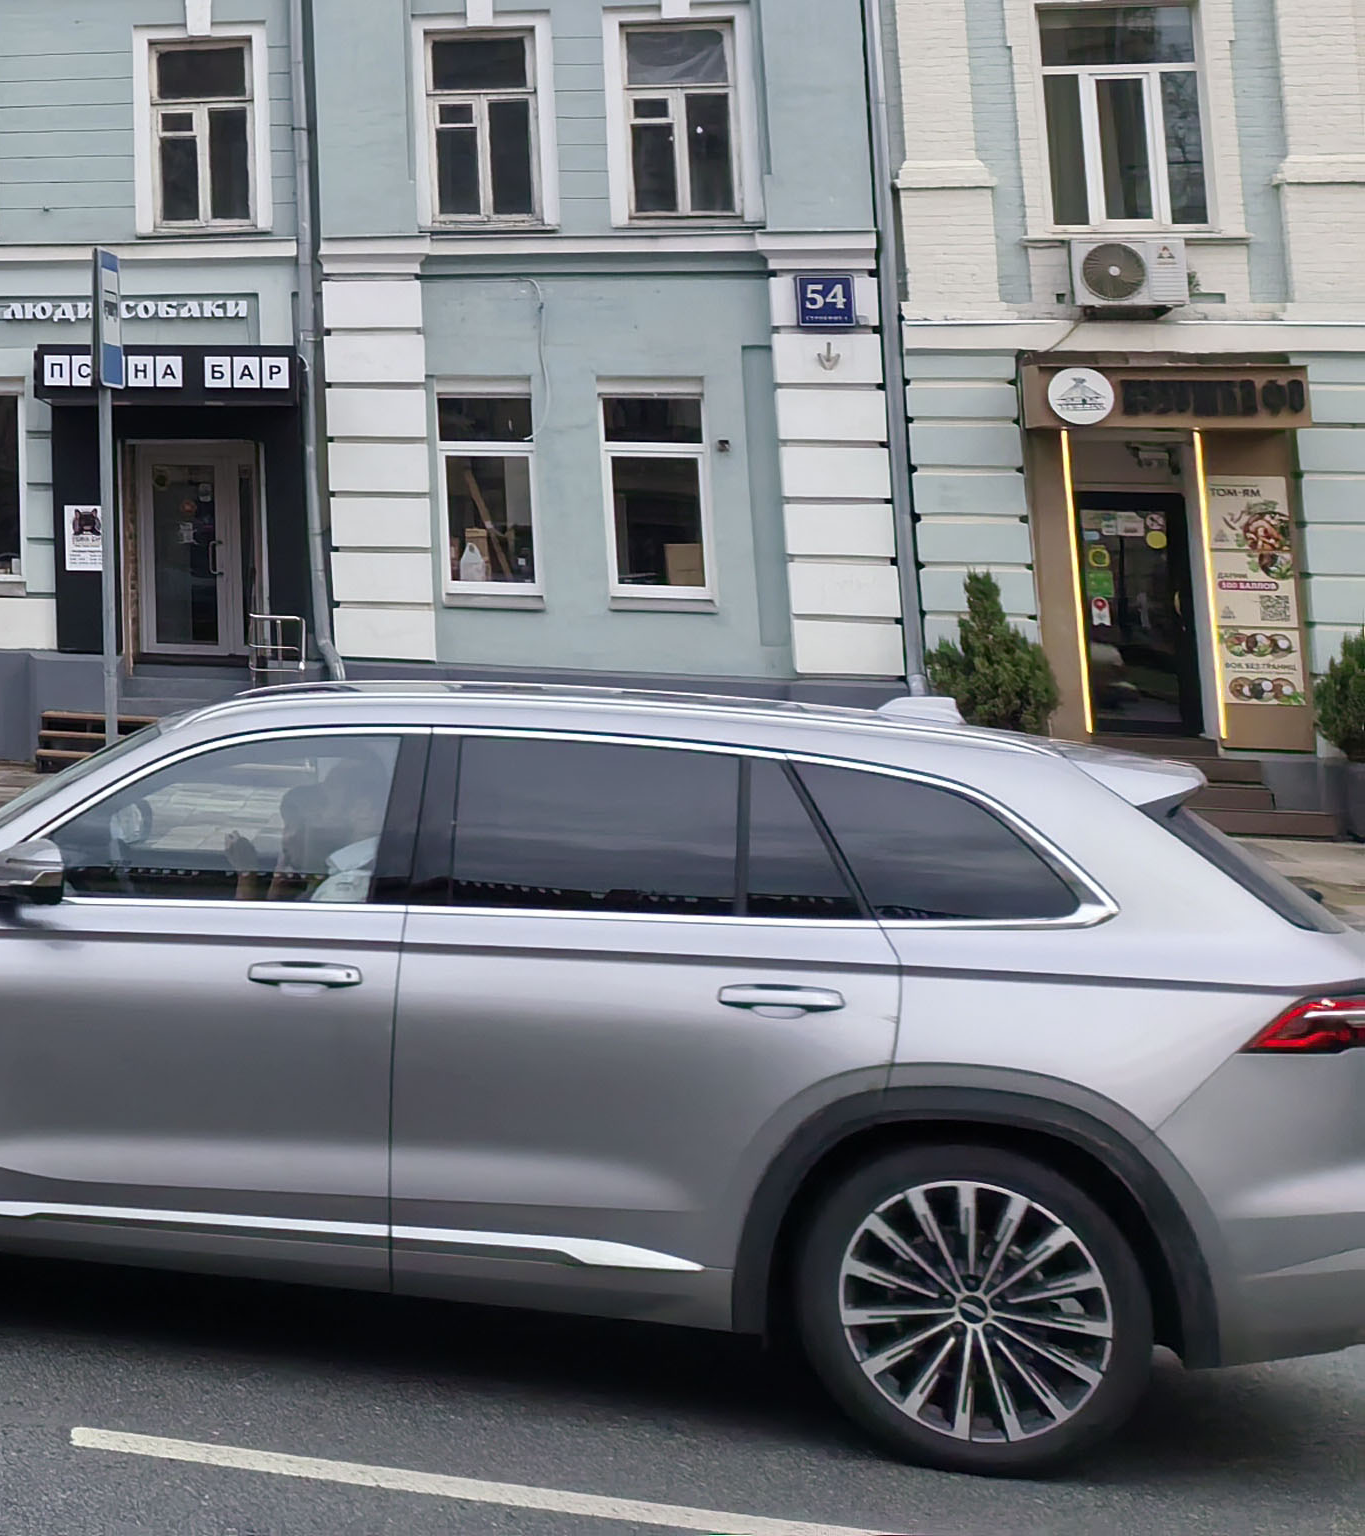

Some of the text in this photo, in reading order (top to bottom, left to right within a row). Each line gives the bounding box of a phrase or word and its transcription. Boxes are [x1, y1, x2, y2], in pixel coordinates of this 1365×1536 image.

[805, 284, 847, 309] 54
[120, 300, 248, 319] СОБАКИ
[50, 362, 282, 381] ПСНА БАР
[1209, 487, 1261, 497] ТОМ-ЯМ
